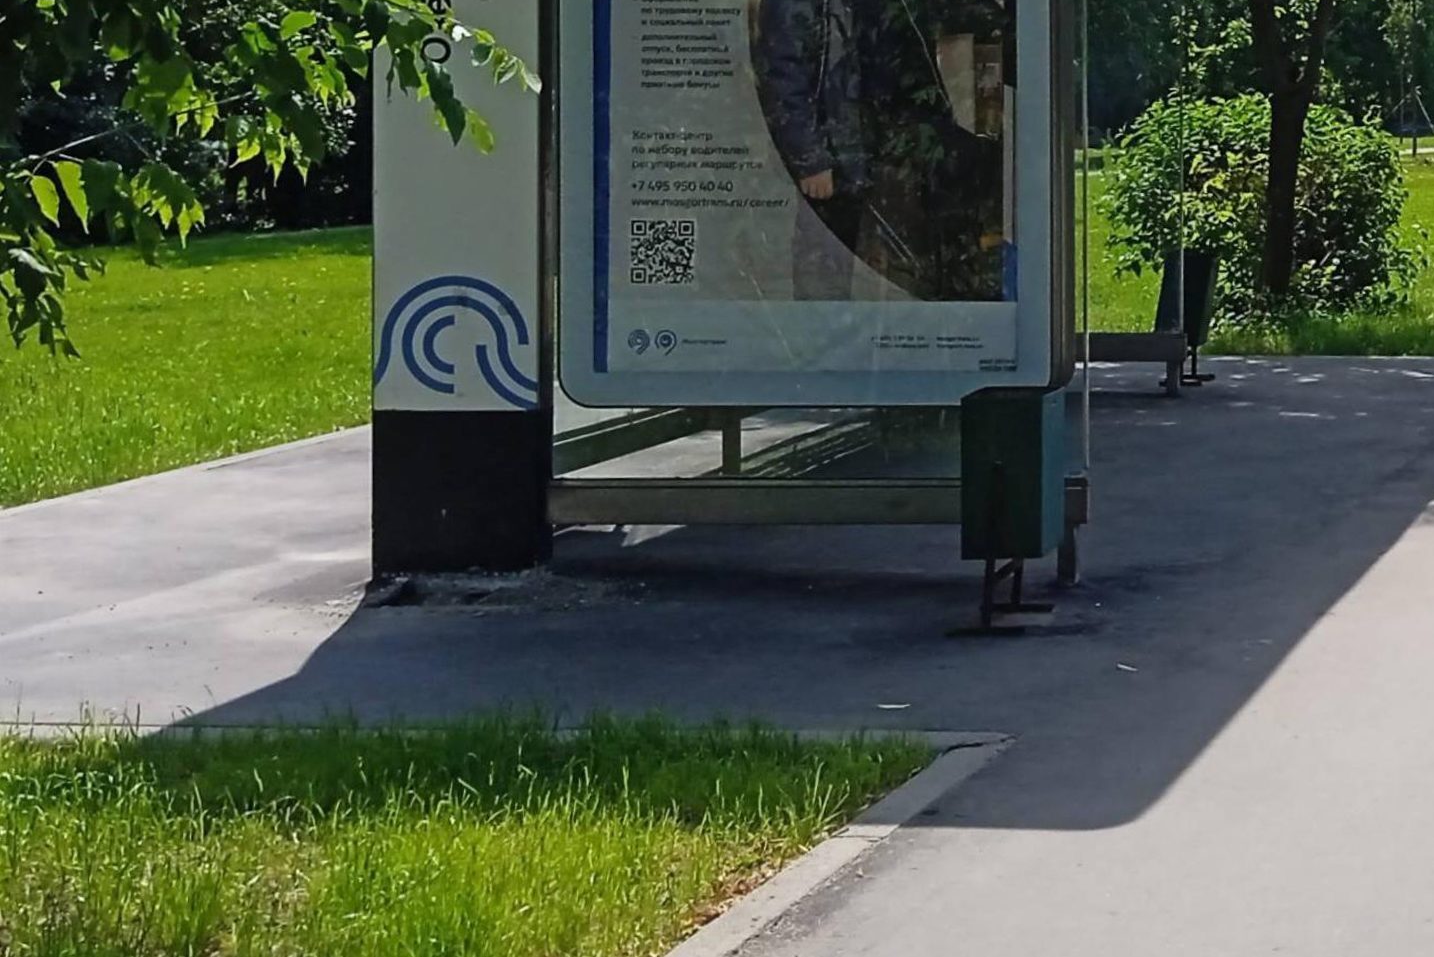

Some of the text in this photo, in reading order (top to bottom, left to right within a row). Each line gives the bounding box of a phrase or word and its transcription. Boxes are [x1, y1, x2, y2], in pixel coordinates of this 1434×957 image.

[648, 181, 670, 192] 495
[673, 181, 697, 192] 950
[699, 181, 715, 192] 40
[717, 181, 734, 192] 40
